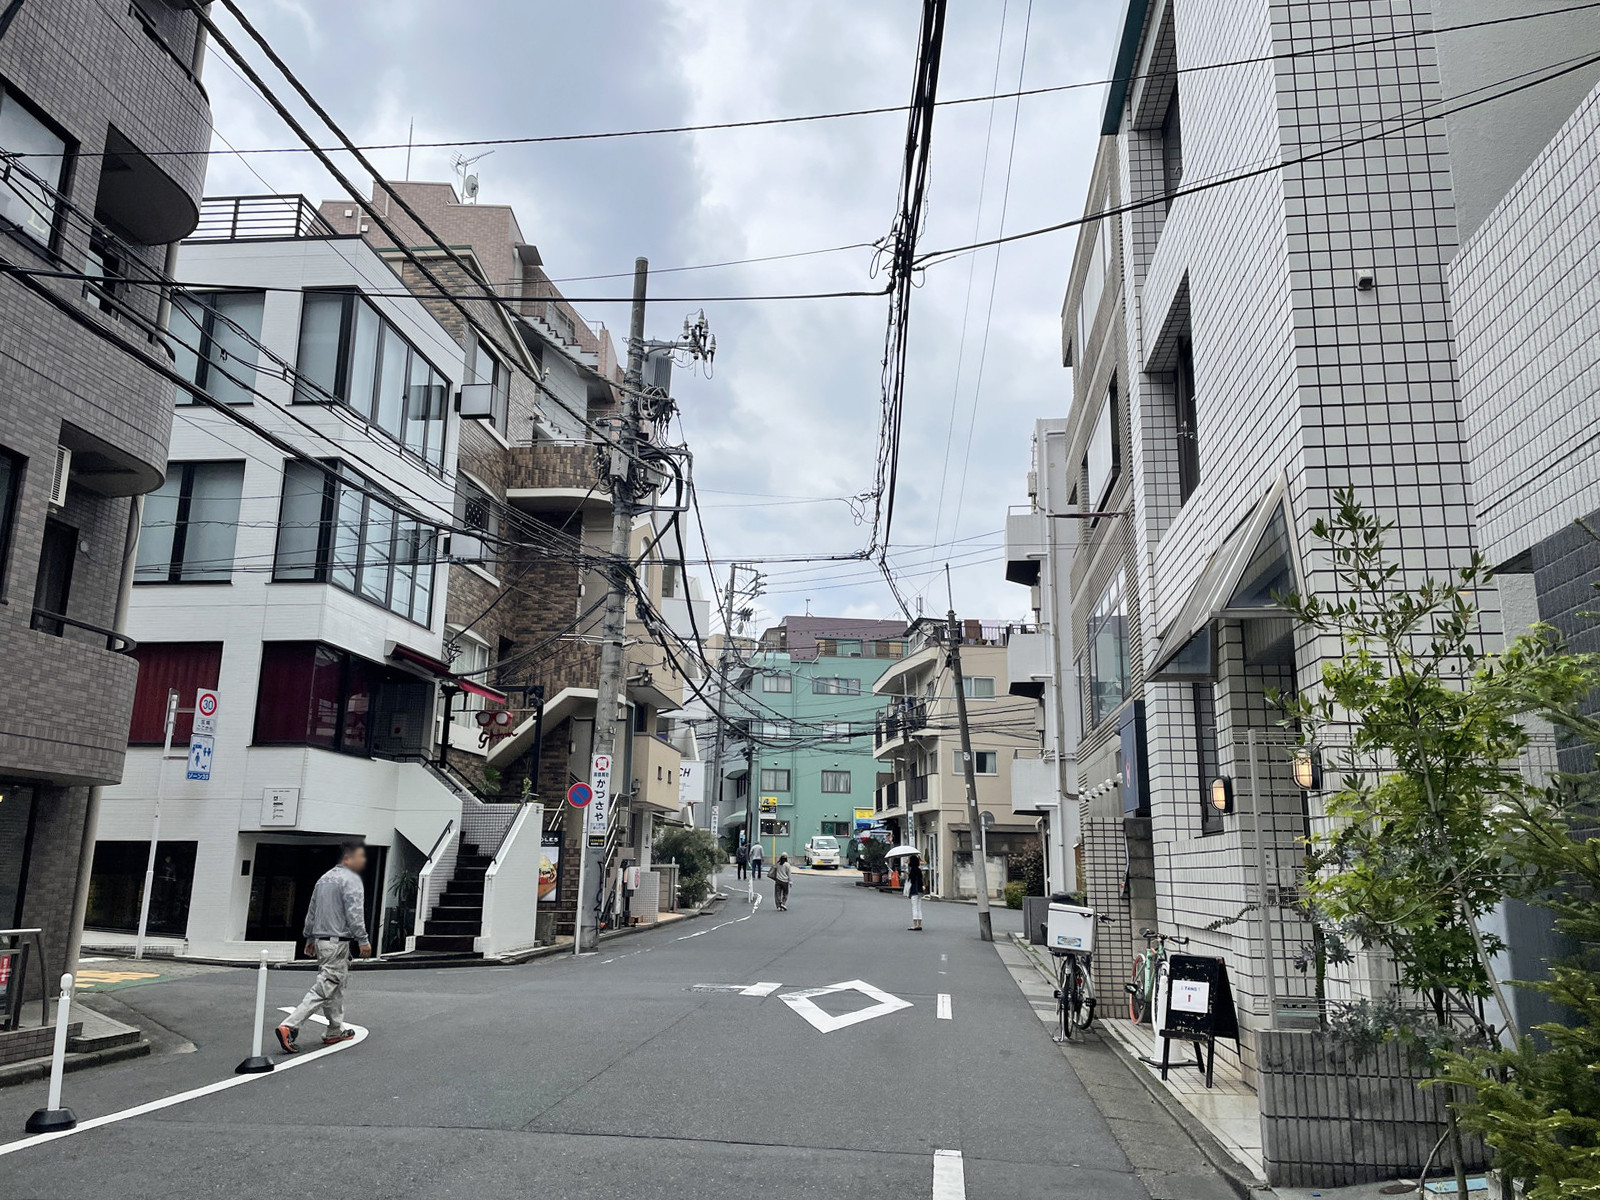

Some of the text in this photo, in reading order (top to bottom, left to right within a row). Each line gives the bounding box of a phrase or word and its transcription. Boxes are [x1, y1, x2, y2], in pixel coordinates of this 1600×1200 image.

[203, 700, 214, 710] 30
[594, 779, 606, 821] かづさや
